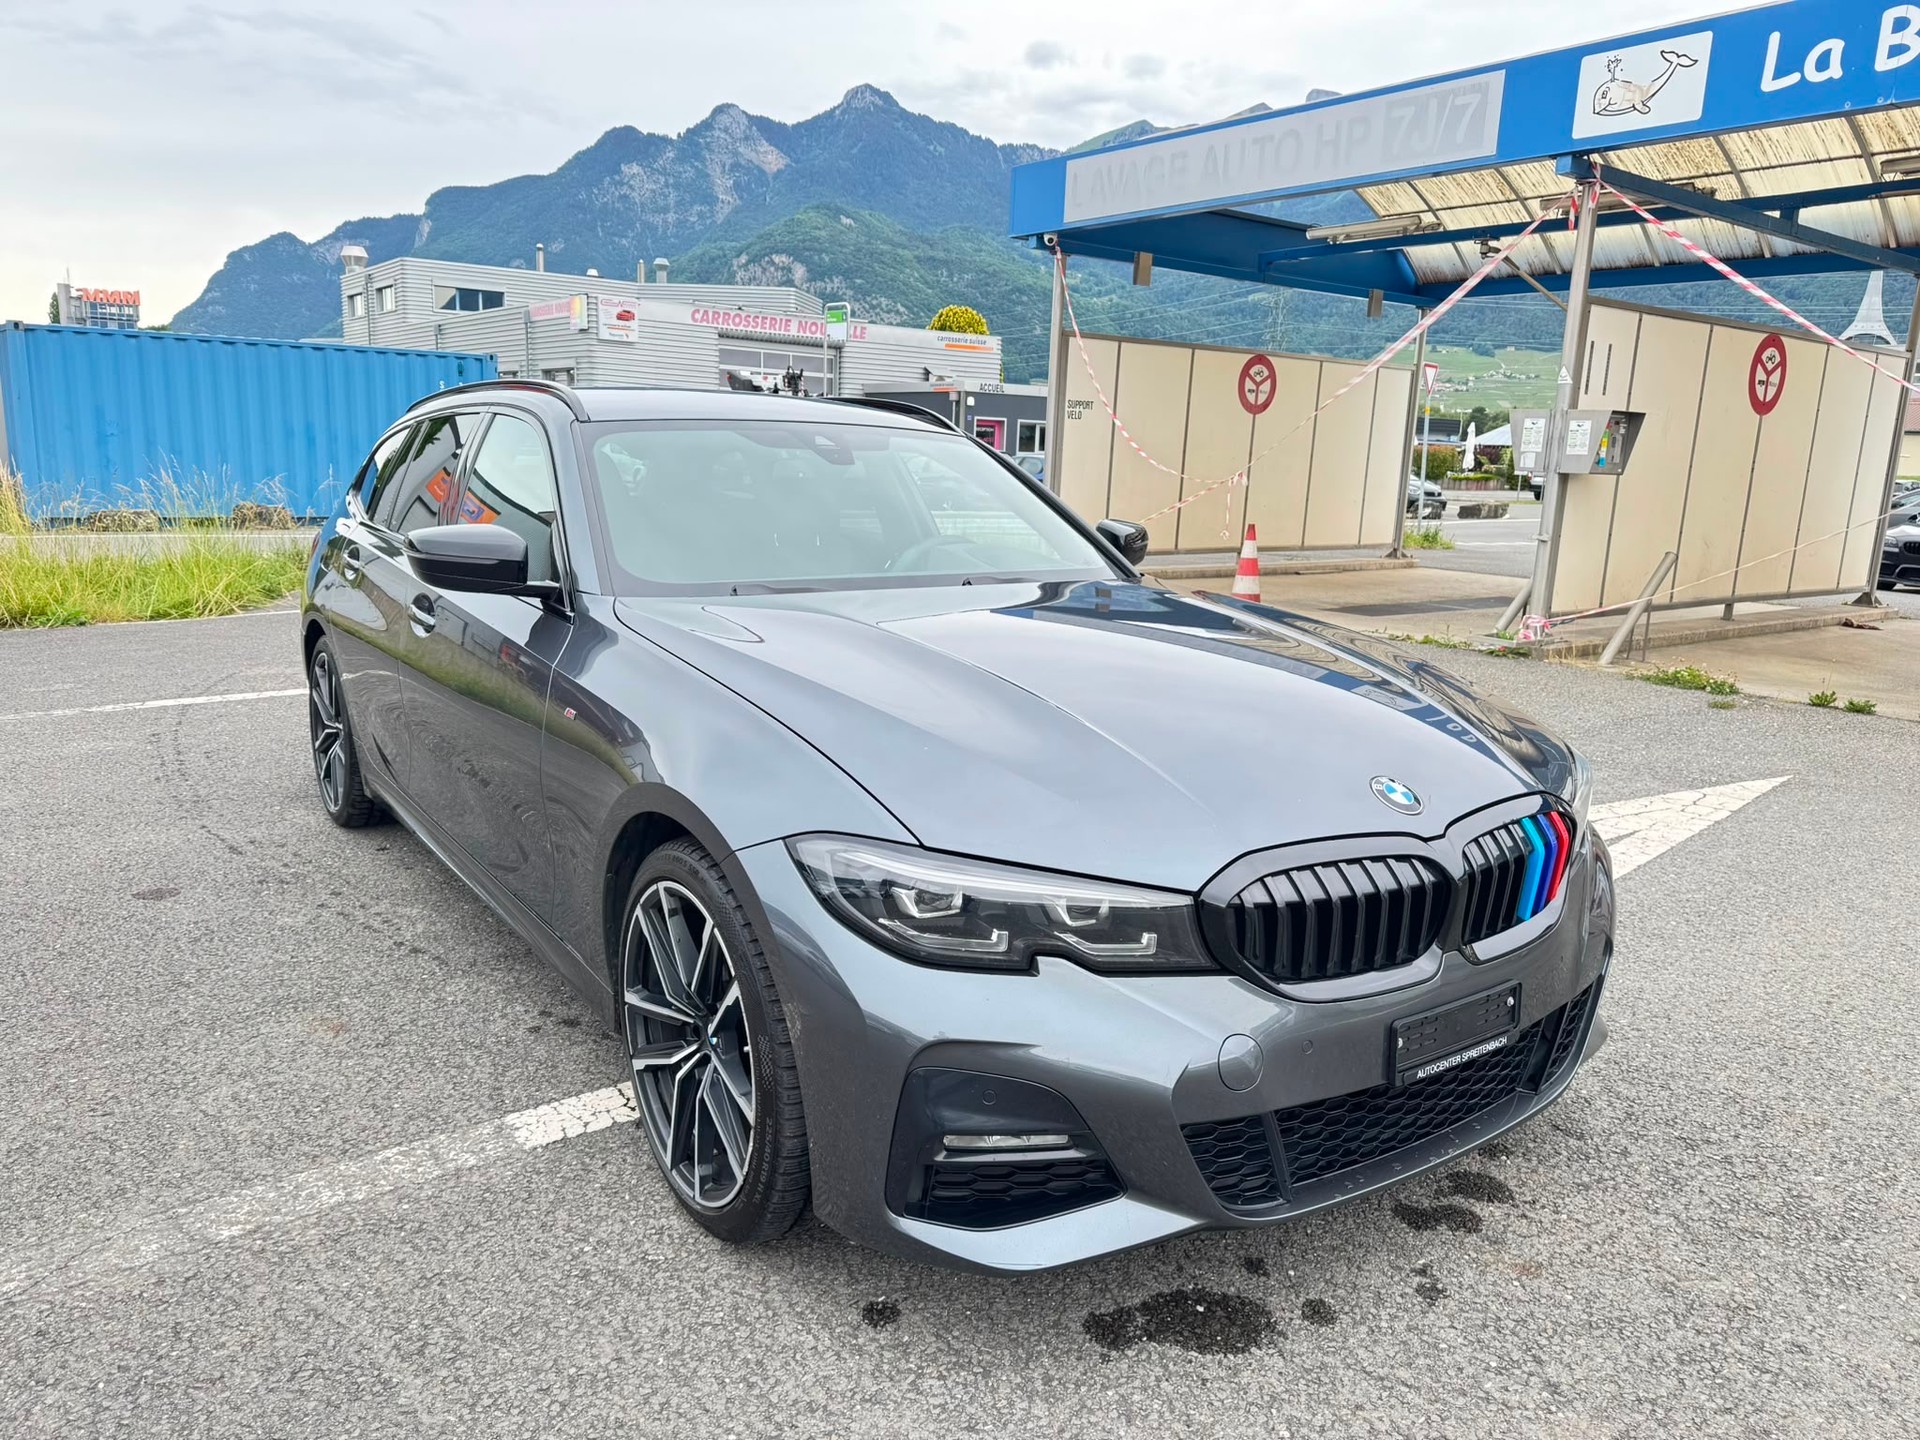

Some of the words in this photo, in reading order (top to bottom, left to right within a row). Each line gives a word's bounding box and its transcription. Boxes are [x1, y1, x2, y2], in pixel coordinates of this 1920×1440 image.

[1760, 31, 1846, 93] La
[1201, 128, 1303, 188] AUTO
[1314, 115, 1369, 172] HP
[690, 308, 792, 333] CARROSSERIE
[979, 383, 1004, 393] ACCUEIL
[1067, 400, 1094, 410] SUPPORT
[1067, 410, 1082, 420] VELO
[1416, 1055, 1461, 1079] AUTOCENTER
[1461, 1036, 1508, 1062] SPREITENBACH
